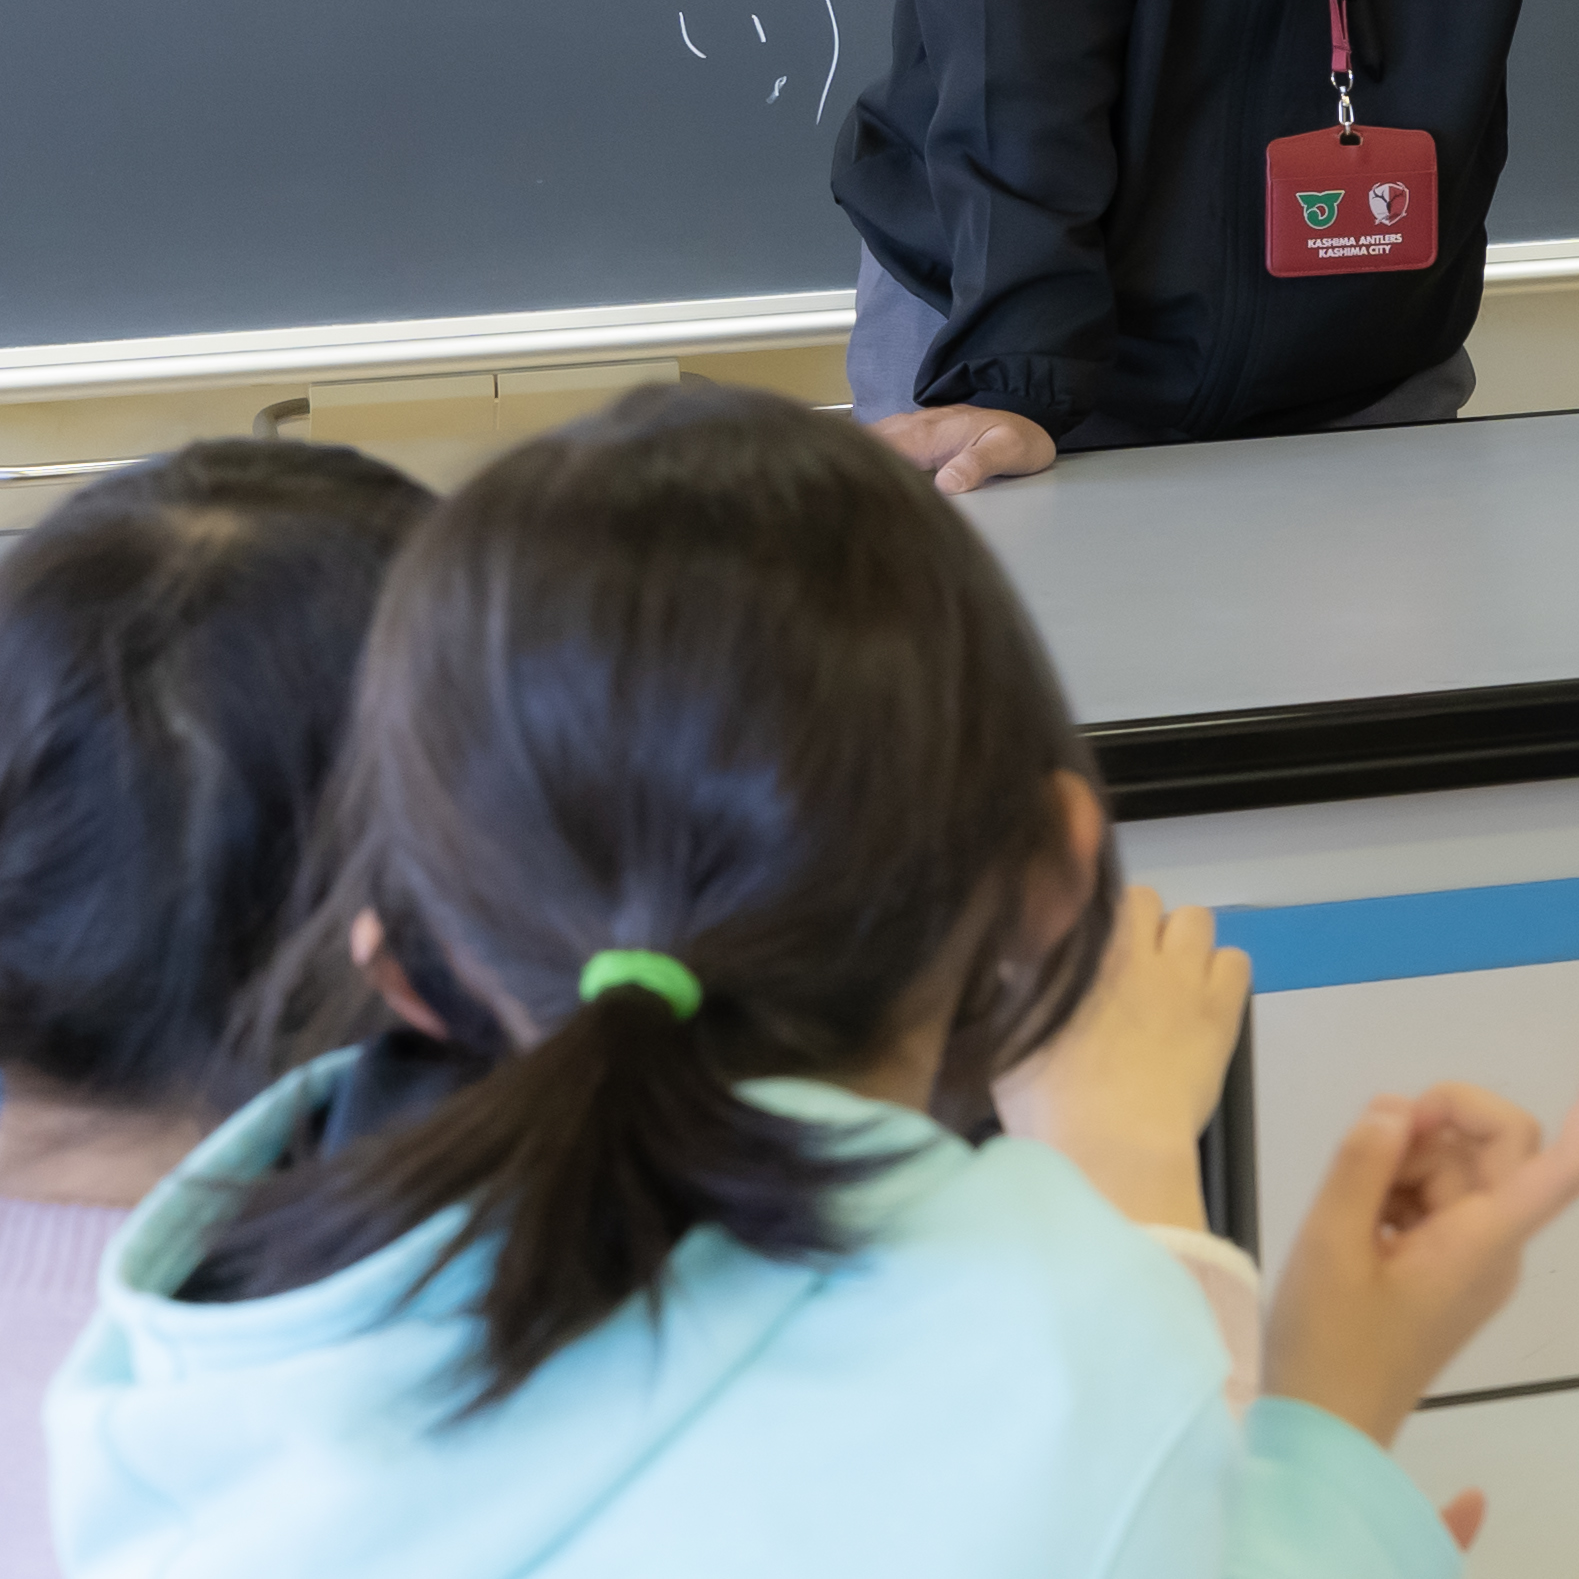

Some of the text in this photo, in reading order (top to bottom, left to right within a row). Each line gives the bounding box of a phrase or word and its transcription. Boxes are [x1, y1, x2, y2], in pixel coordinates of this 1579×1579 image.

[1307, 233, 1403, 249] KASHIMA ANTLERS
[1318, 244, 1392, 258] KASHIMA CITY
